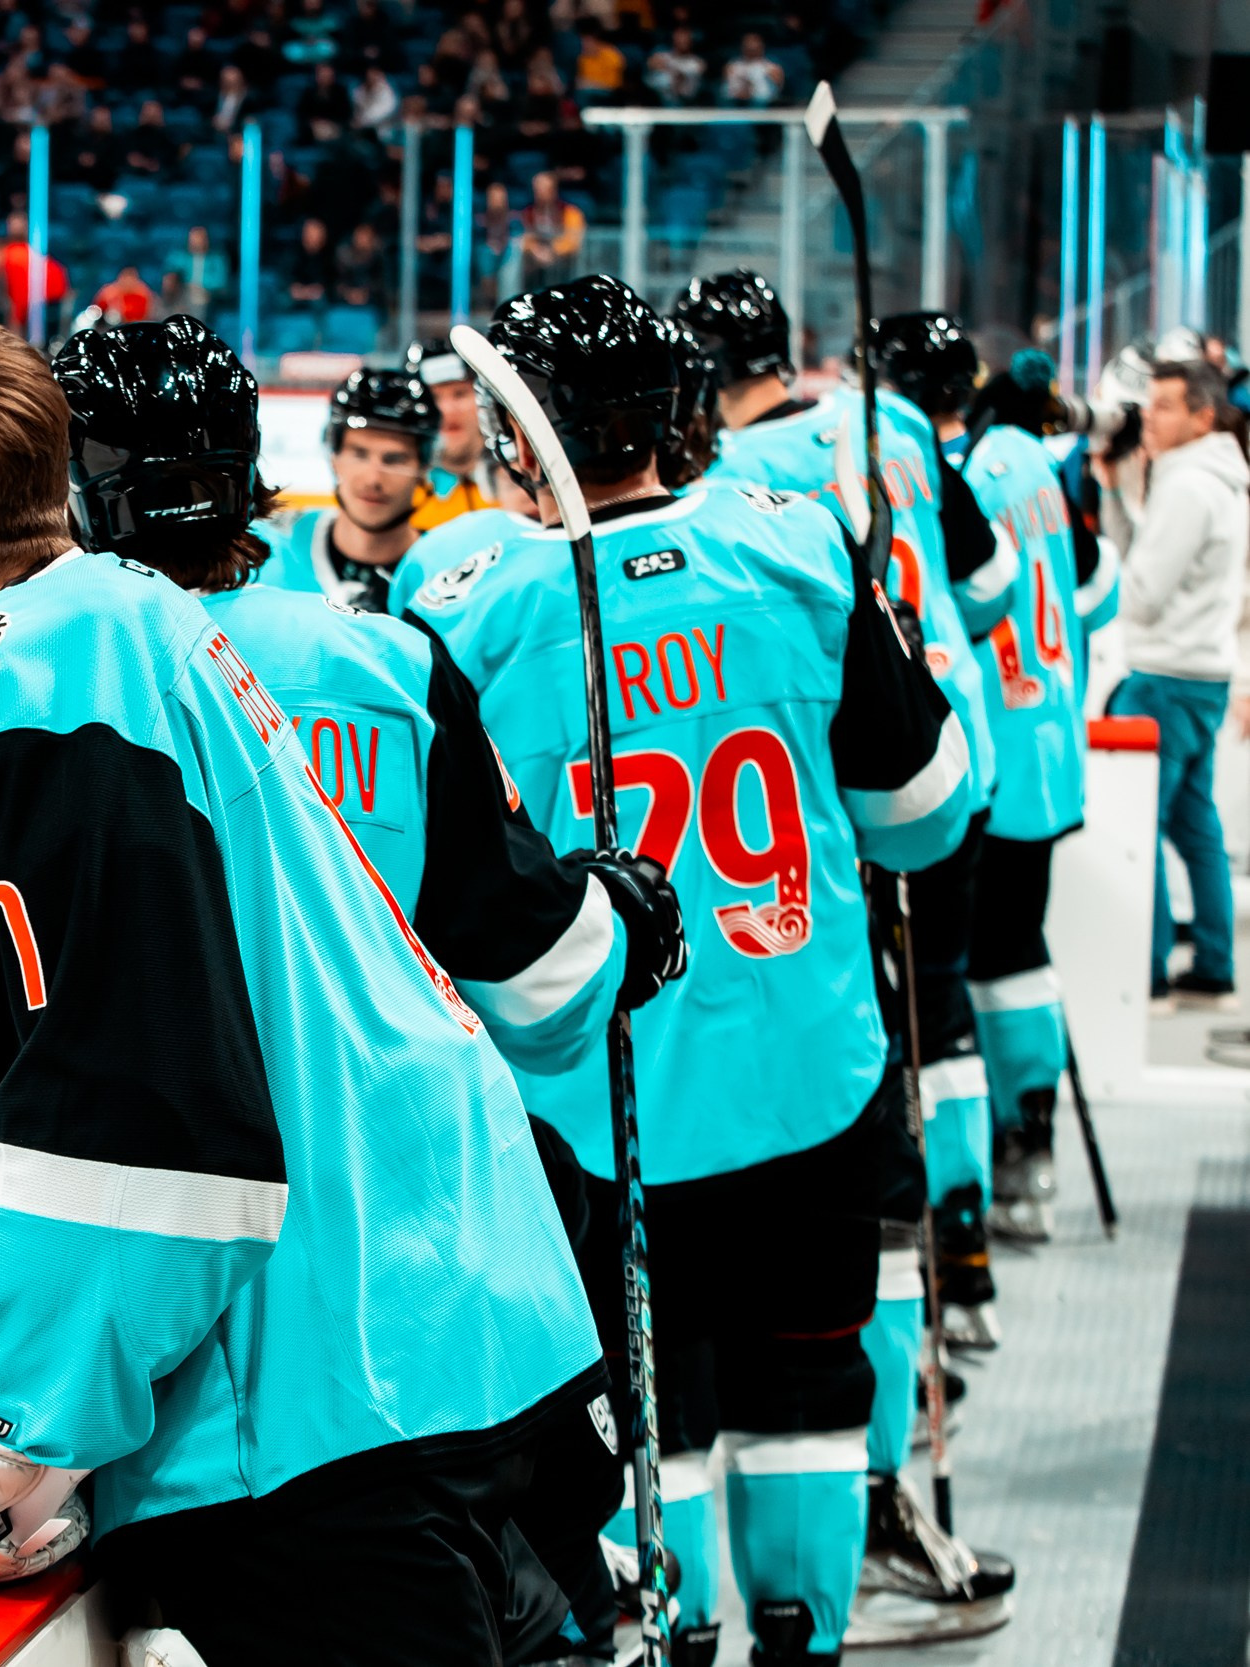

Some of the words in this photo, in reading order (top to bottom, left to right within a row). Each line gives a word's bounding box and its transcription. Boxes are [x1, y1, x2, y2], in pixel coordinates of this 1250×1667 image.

[144, 501, 212, 518] TRUE
[611, 623, 726, 720] ROY
[292, 715, 381, 814] OV
[566, 725, 812, 960] 79
[624, 1264, 645, 1402] JETSPEED
